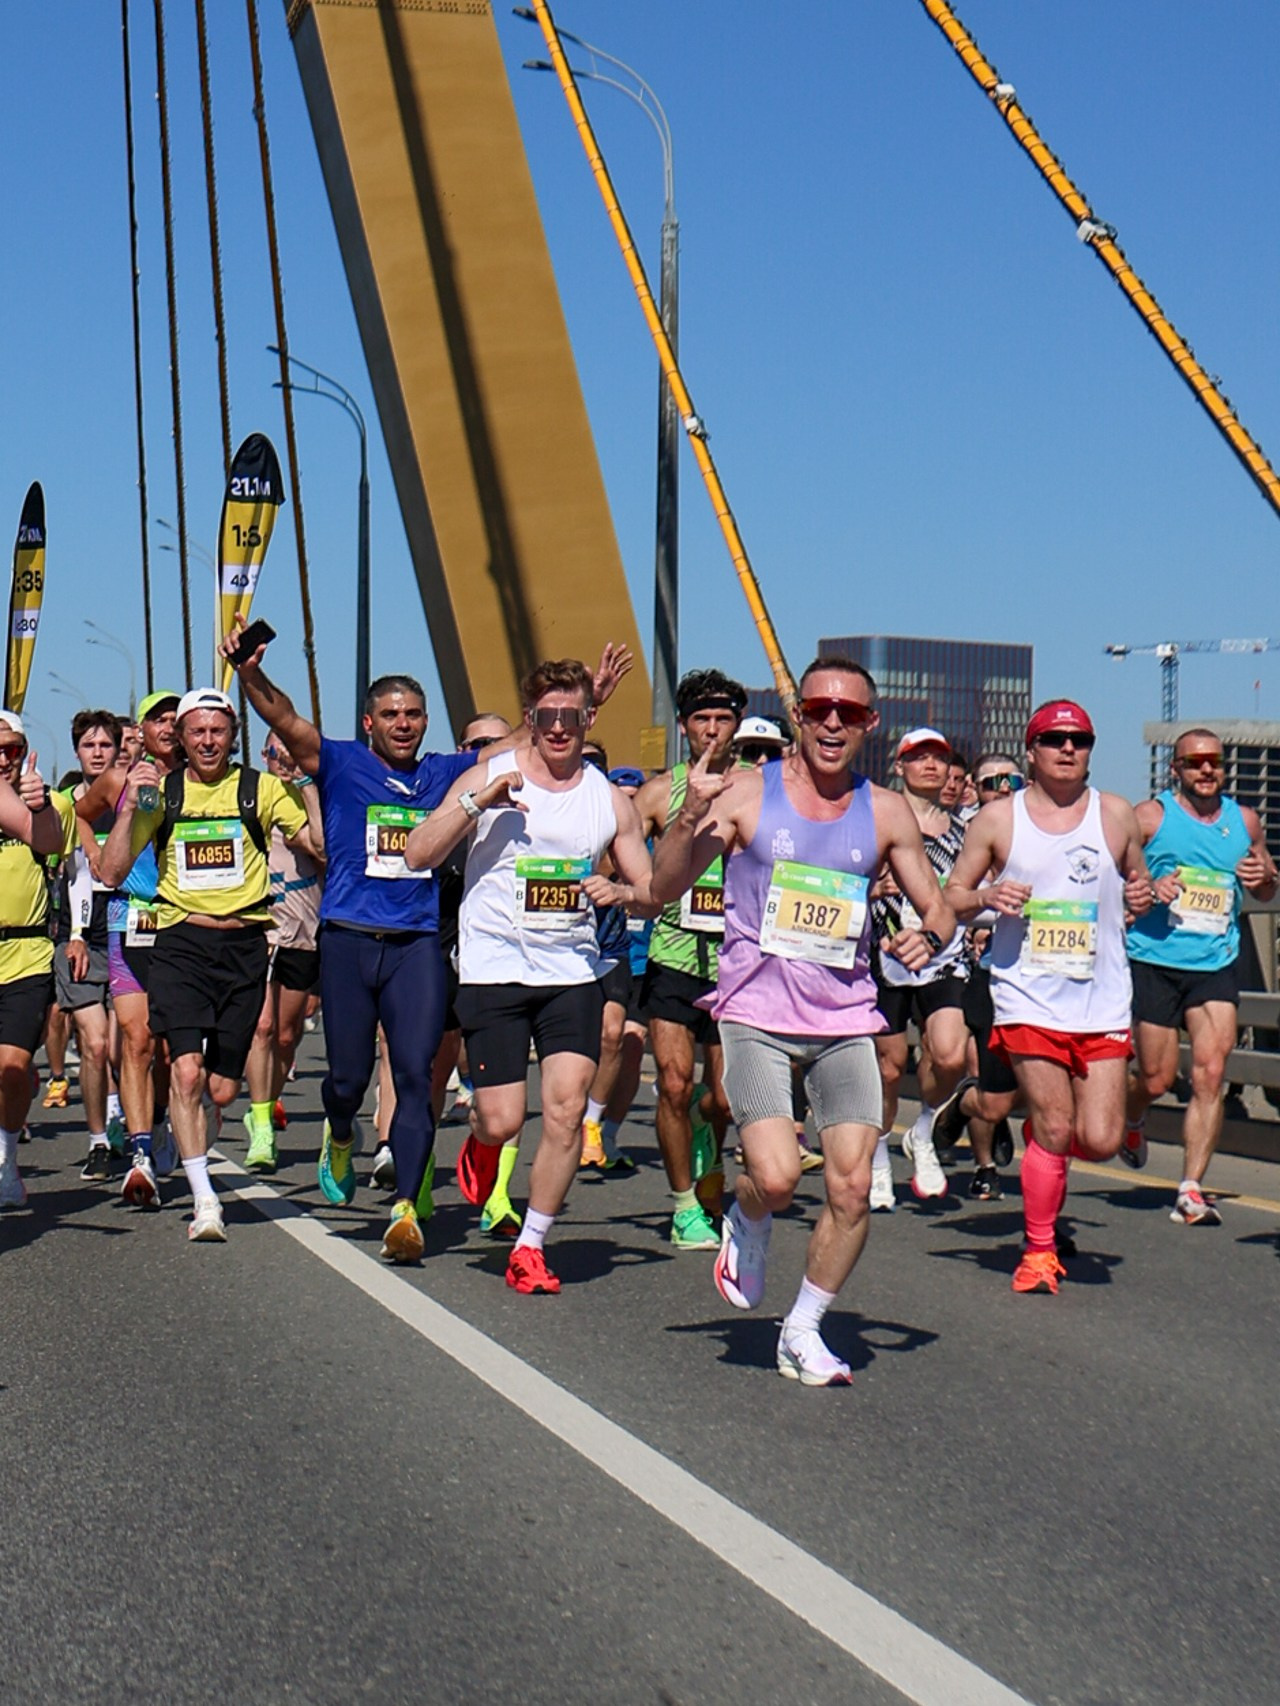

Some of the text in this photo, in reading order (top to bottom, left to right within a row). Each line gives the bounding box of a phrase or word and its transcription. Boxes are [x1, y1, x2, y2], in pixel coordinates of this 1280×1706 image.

[15, 569, 42, 593] :35
[381, 832, 407, 850] 160
[189, 845, 232, 864] 16855
[696, 892, 724, 910] 184
[1189, 891, 1221, 909] 7990
[793, 901, 841, 929] 1387
[1037, 929, 1086, 948] 21284
